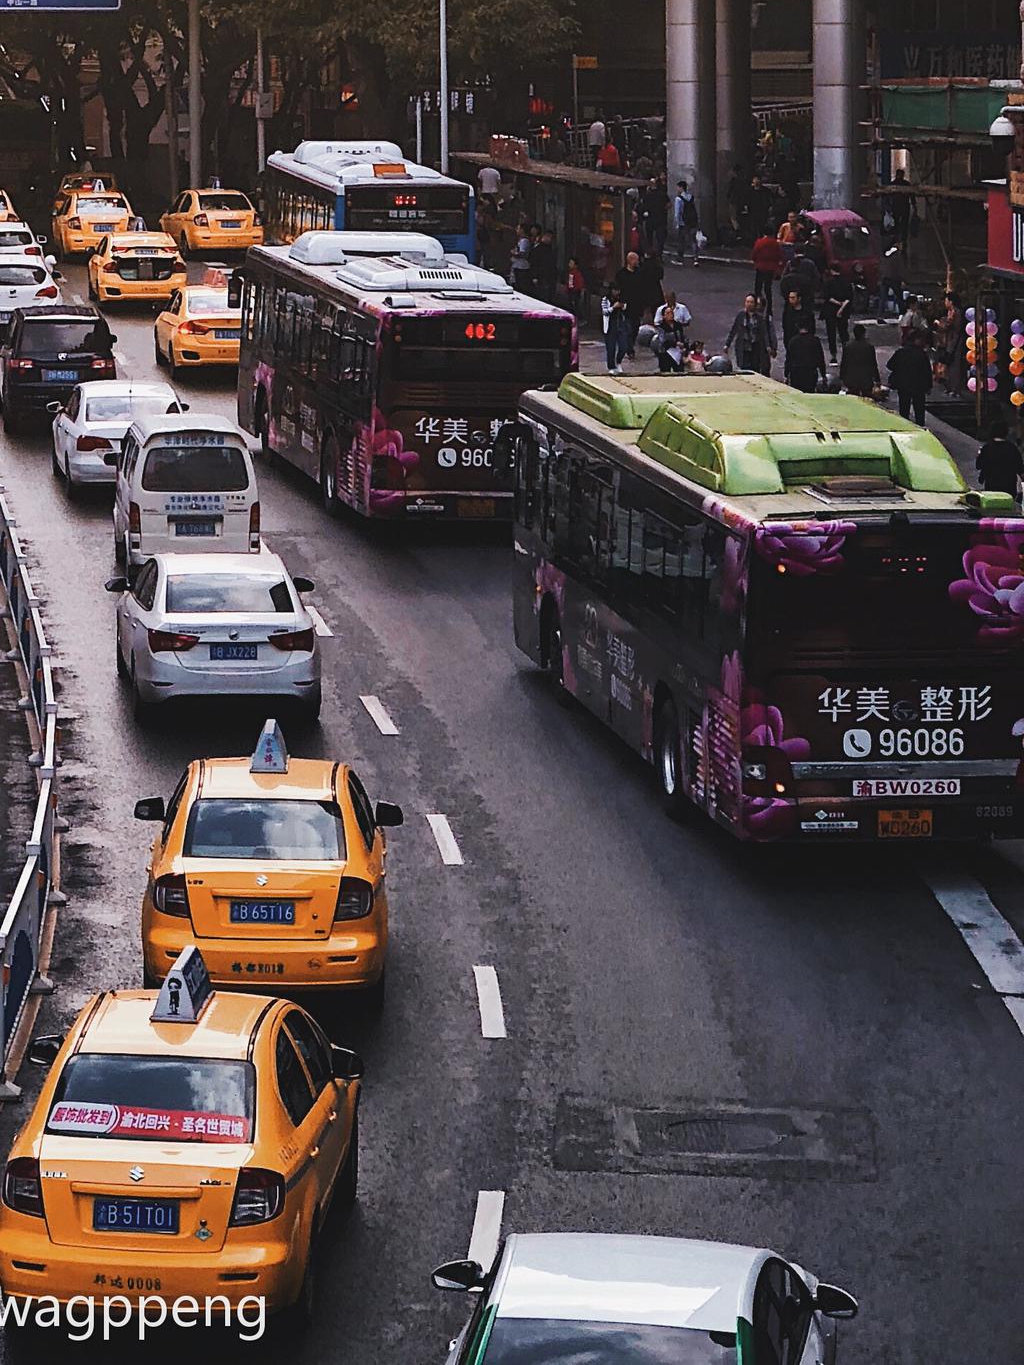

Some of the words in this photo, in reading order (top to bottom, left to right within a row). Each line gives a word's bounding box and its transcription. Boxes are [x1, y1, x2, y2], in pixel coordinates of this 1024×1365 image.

[415, 417, 468, 444] 华美
[818, 687, 890, 723] 华美
[920, 685, 993, 722] 整形
[879, 728, 965, 756] 96086
[856, 780, 958, 796] 渝BW0260
